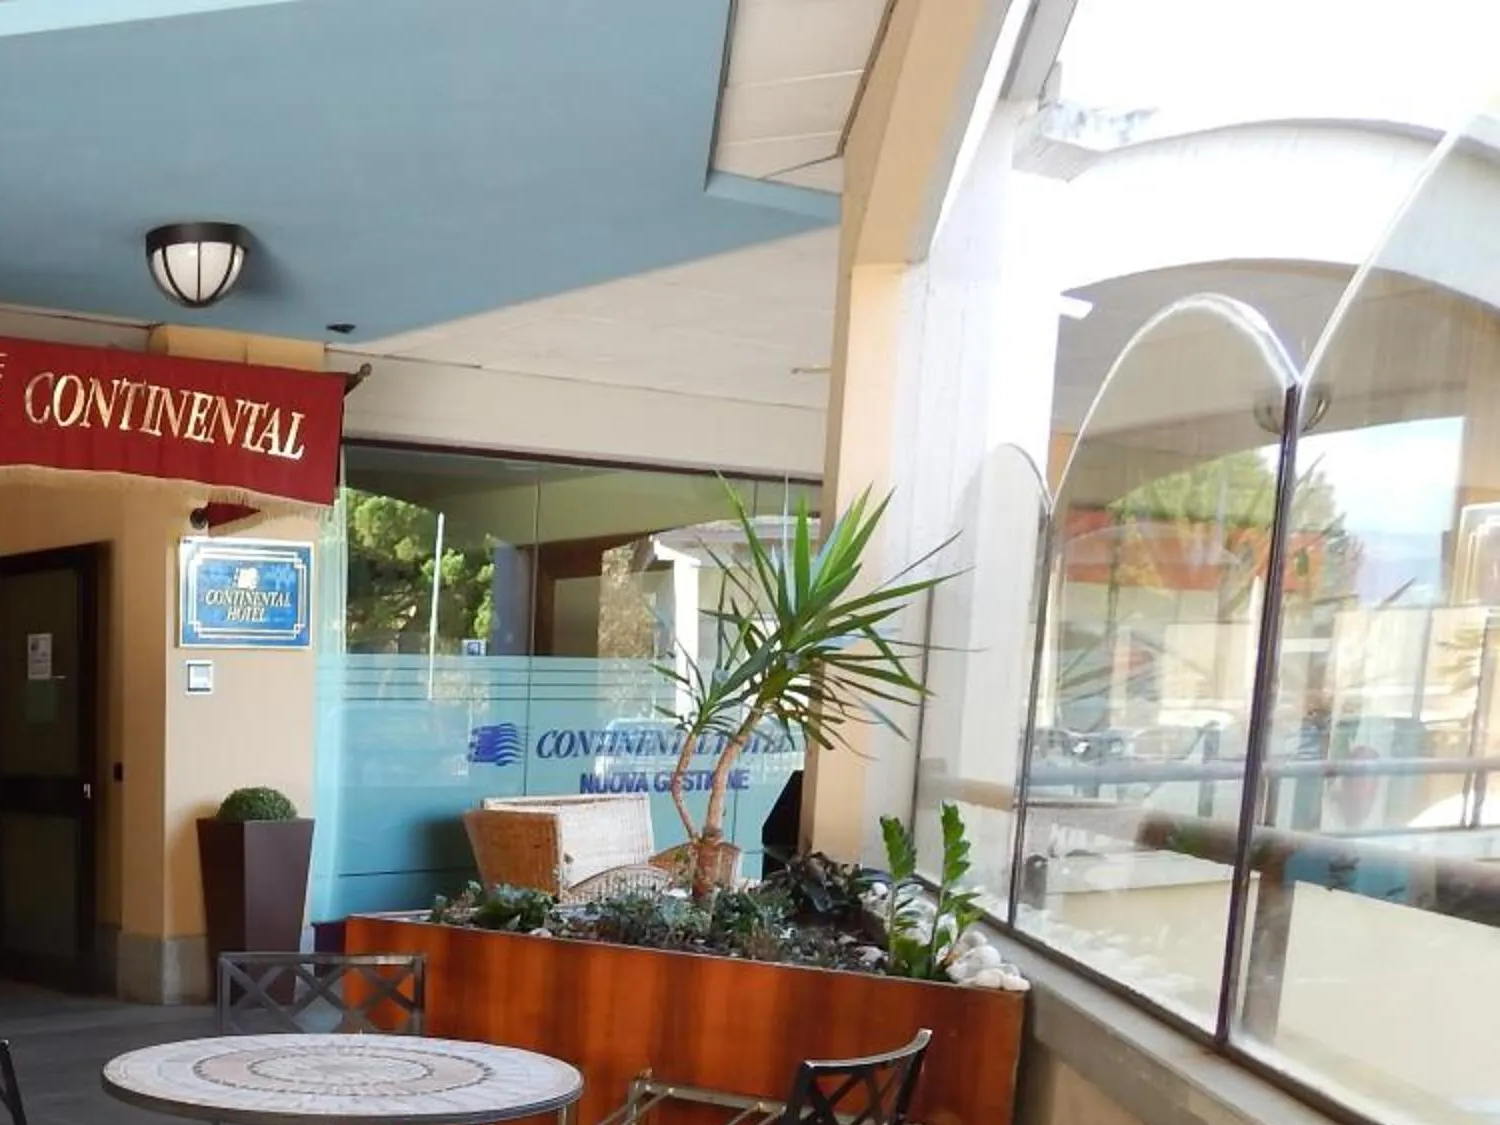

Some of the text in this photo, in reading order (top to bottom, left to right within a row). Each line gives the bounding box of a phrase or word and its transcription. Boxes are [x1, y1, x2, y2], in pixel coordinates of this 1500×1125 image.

[24, 371, 306, 461] CONTINENTAL
[205, 588, 292, 607] CONTINENTAL
[227, 606, 267, 623] HOTEL
[580, 768, 750, 794] NUOVA GSTINE
